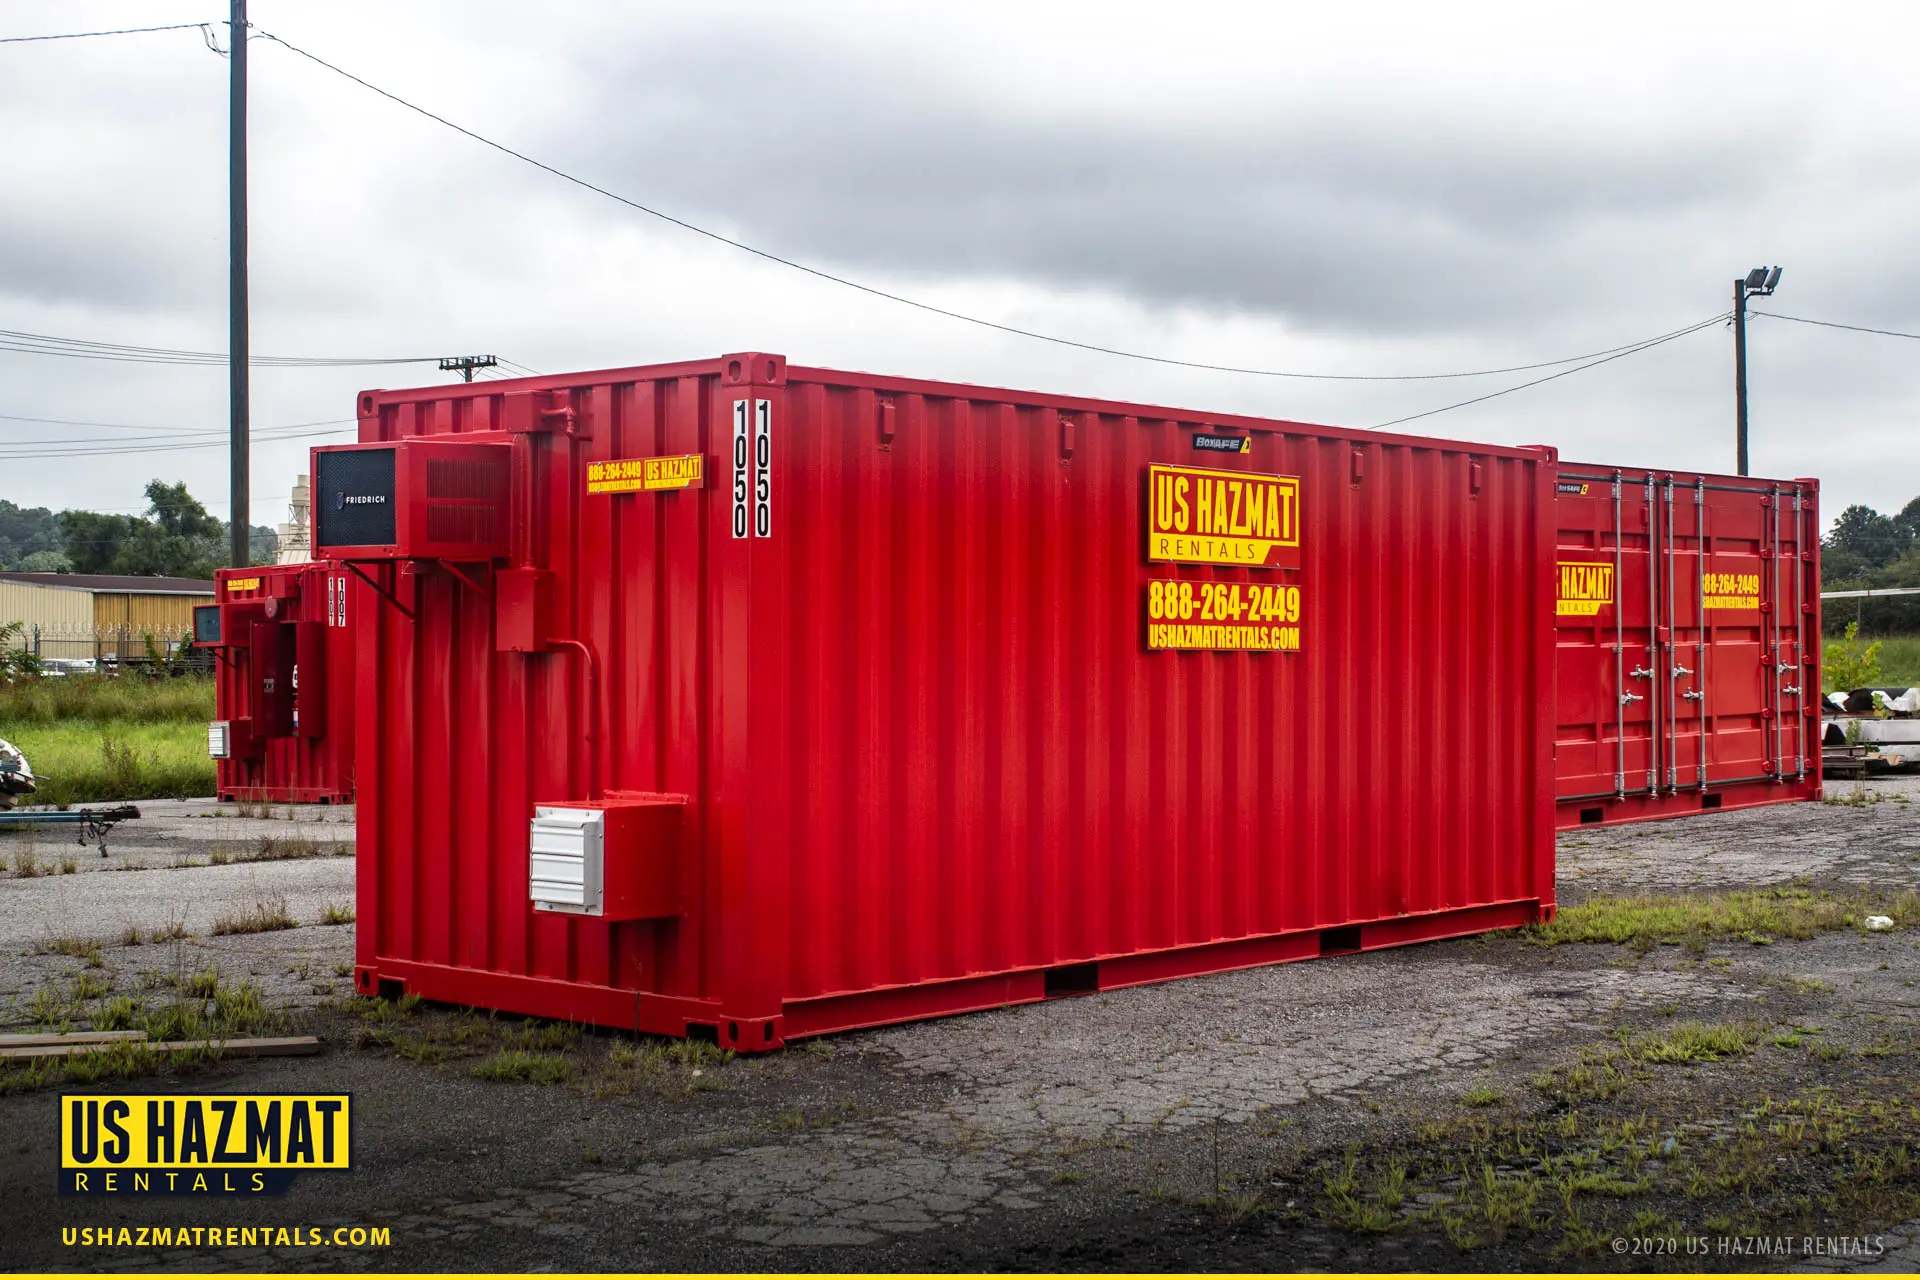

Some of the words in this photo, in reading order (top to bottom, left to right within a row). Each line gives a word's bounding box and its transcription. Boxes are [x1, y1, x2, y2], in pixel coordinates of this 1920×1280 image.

[588, 461, 641, 481] 888-264-2449
[647, 461, 659, 480] US
[661, 458, 699, 479] HAZMAT
[734, 400, 747, 537] 1050
[757, 400, 769, 537] 1050
[345, 495, 385, 504] FRIEDRICH
[1158, 475, 1190, 532] US
[1197, 478, 1293, 538] HAZMAT
[1160, 538, 1255, 559] RENTALS
[1561, 566, 1611, 599] HAZMAT
[1703, 573, 1759, 594] 88-264-2449
[1149, 581, 1300, 622] 888-264-2449
[1559, 602, 1592, 613] NTALS
[1149, 624, 1299, 649] USHAZMATRENTALS.COM
